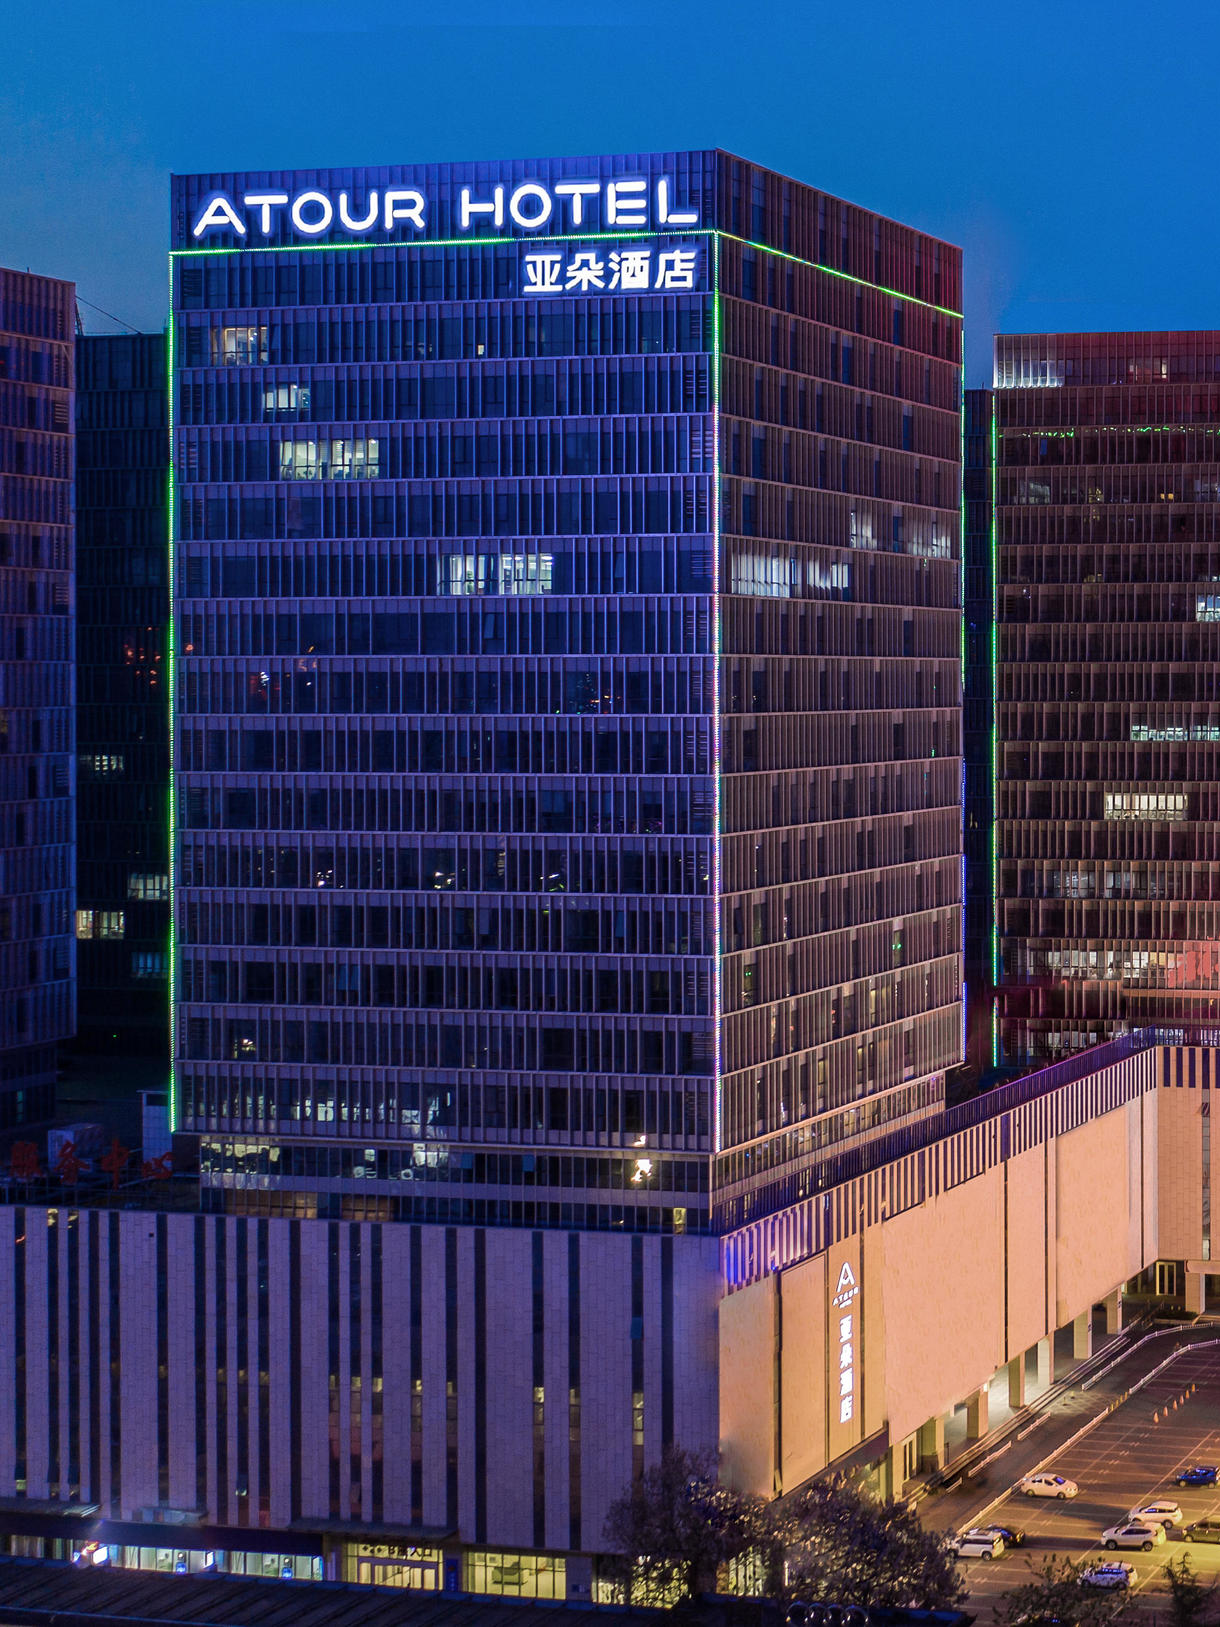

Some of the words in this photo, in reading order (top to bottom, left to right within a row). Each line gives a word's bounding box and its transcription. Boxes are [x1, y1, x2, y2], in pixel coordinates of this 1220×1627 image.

[194, 190, 426, 236] ATOUR
[461, 179, 698, 228] HOTEL
[523, 249, 696, 292] 亚朵酒店
